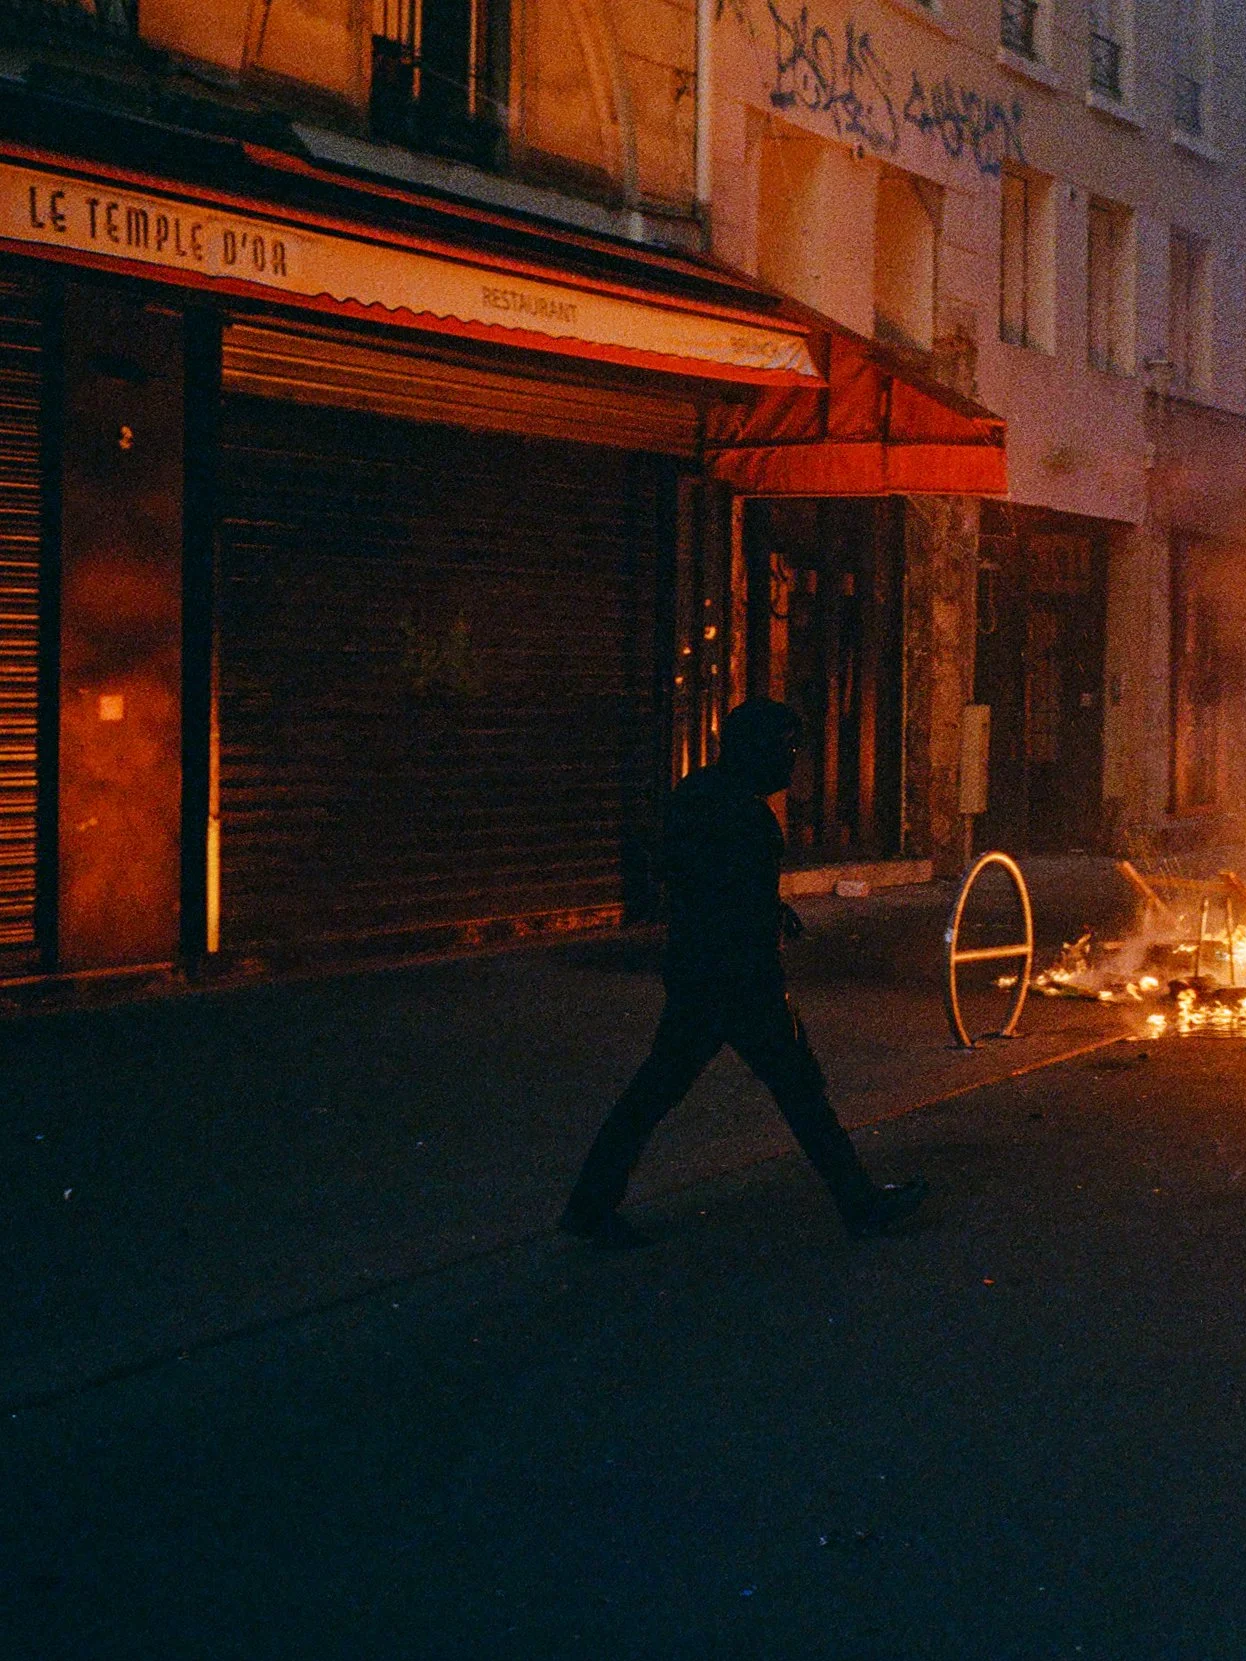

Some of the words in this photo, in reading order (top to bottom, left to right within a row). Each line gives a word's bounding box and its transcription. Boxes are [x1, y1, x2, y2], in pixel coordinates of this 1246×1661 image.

[28, 186, 66, 232] LE
[85, 197, 203, 260] TEMPLE
[223, 230, 287, 277] D'OR
[482, 285, 578, 322] RESTAURANT
